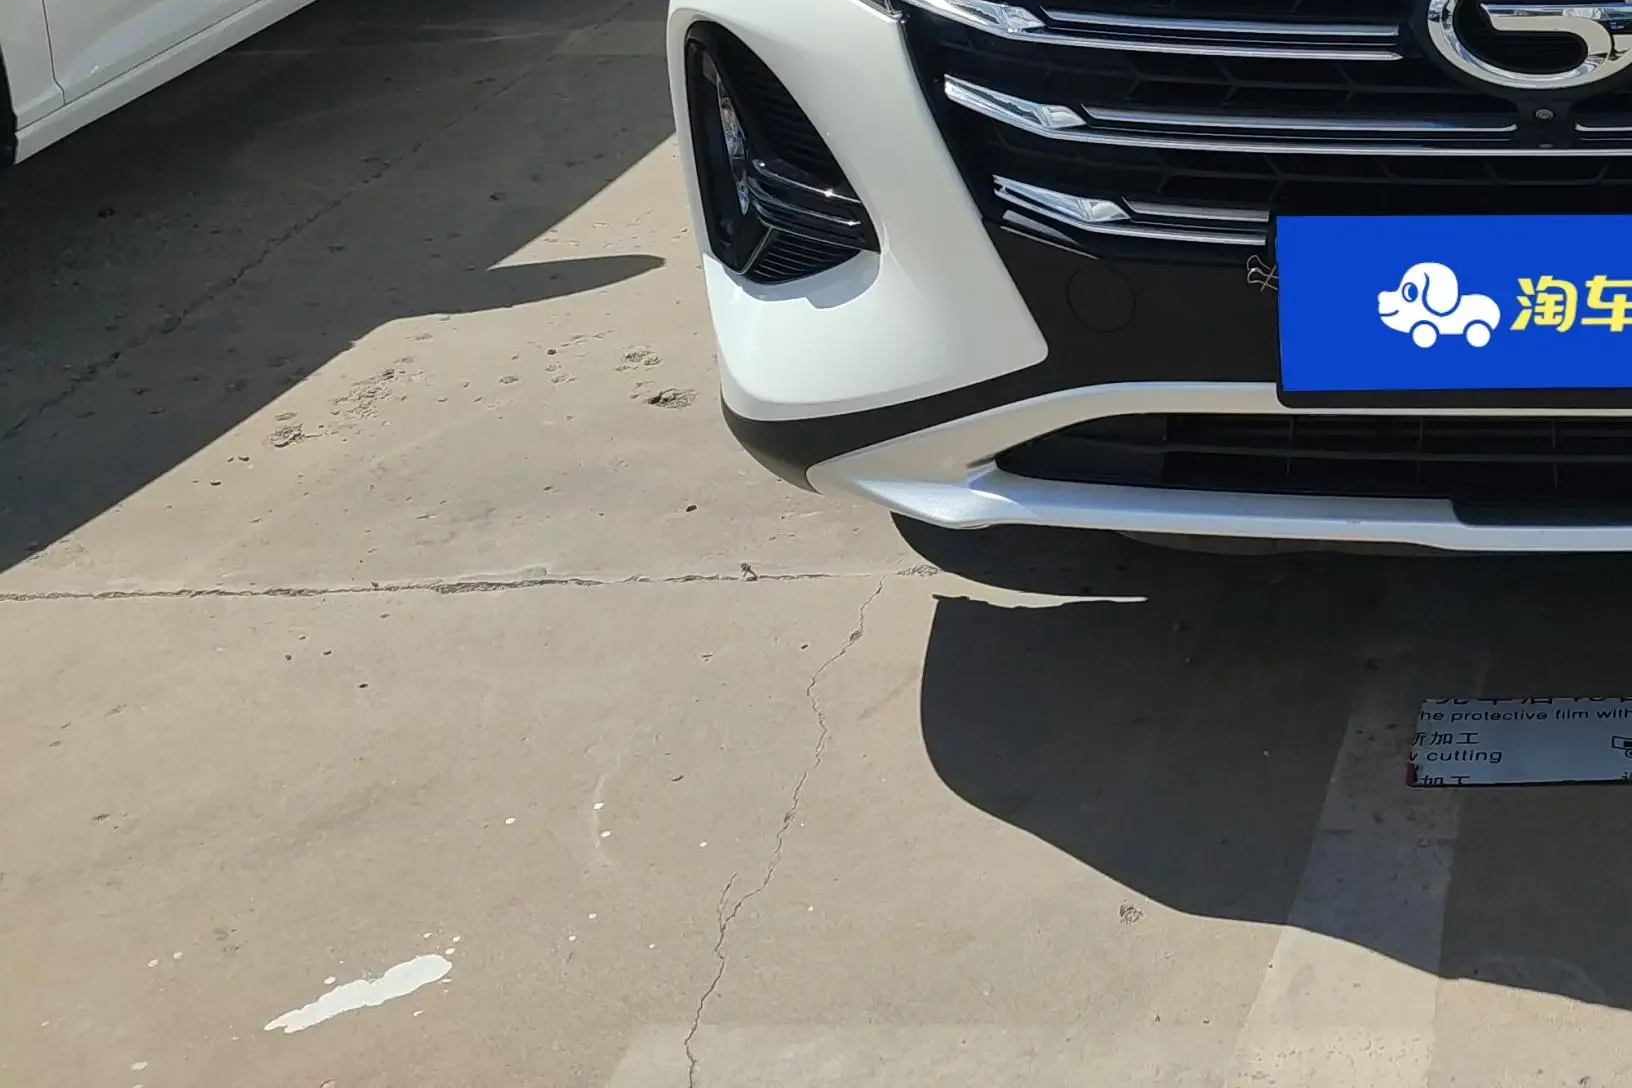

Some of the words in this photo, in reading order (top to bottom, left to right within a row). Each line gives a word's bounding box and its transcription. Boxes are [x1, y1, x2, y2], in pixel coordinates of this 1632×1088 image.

[1451, 709, 1548, 723] protective
[1555, 708, 1589, 720] film
[1426, 750, 1503, 764] cutting
